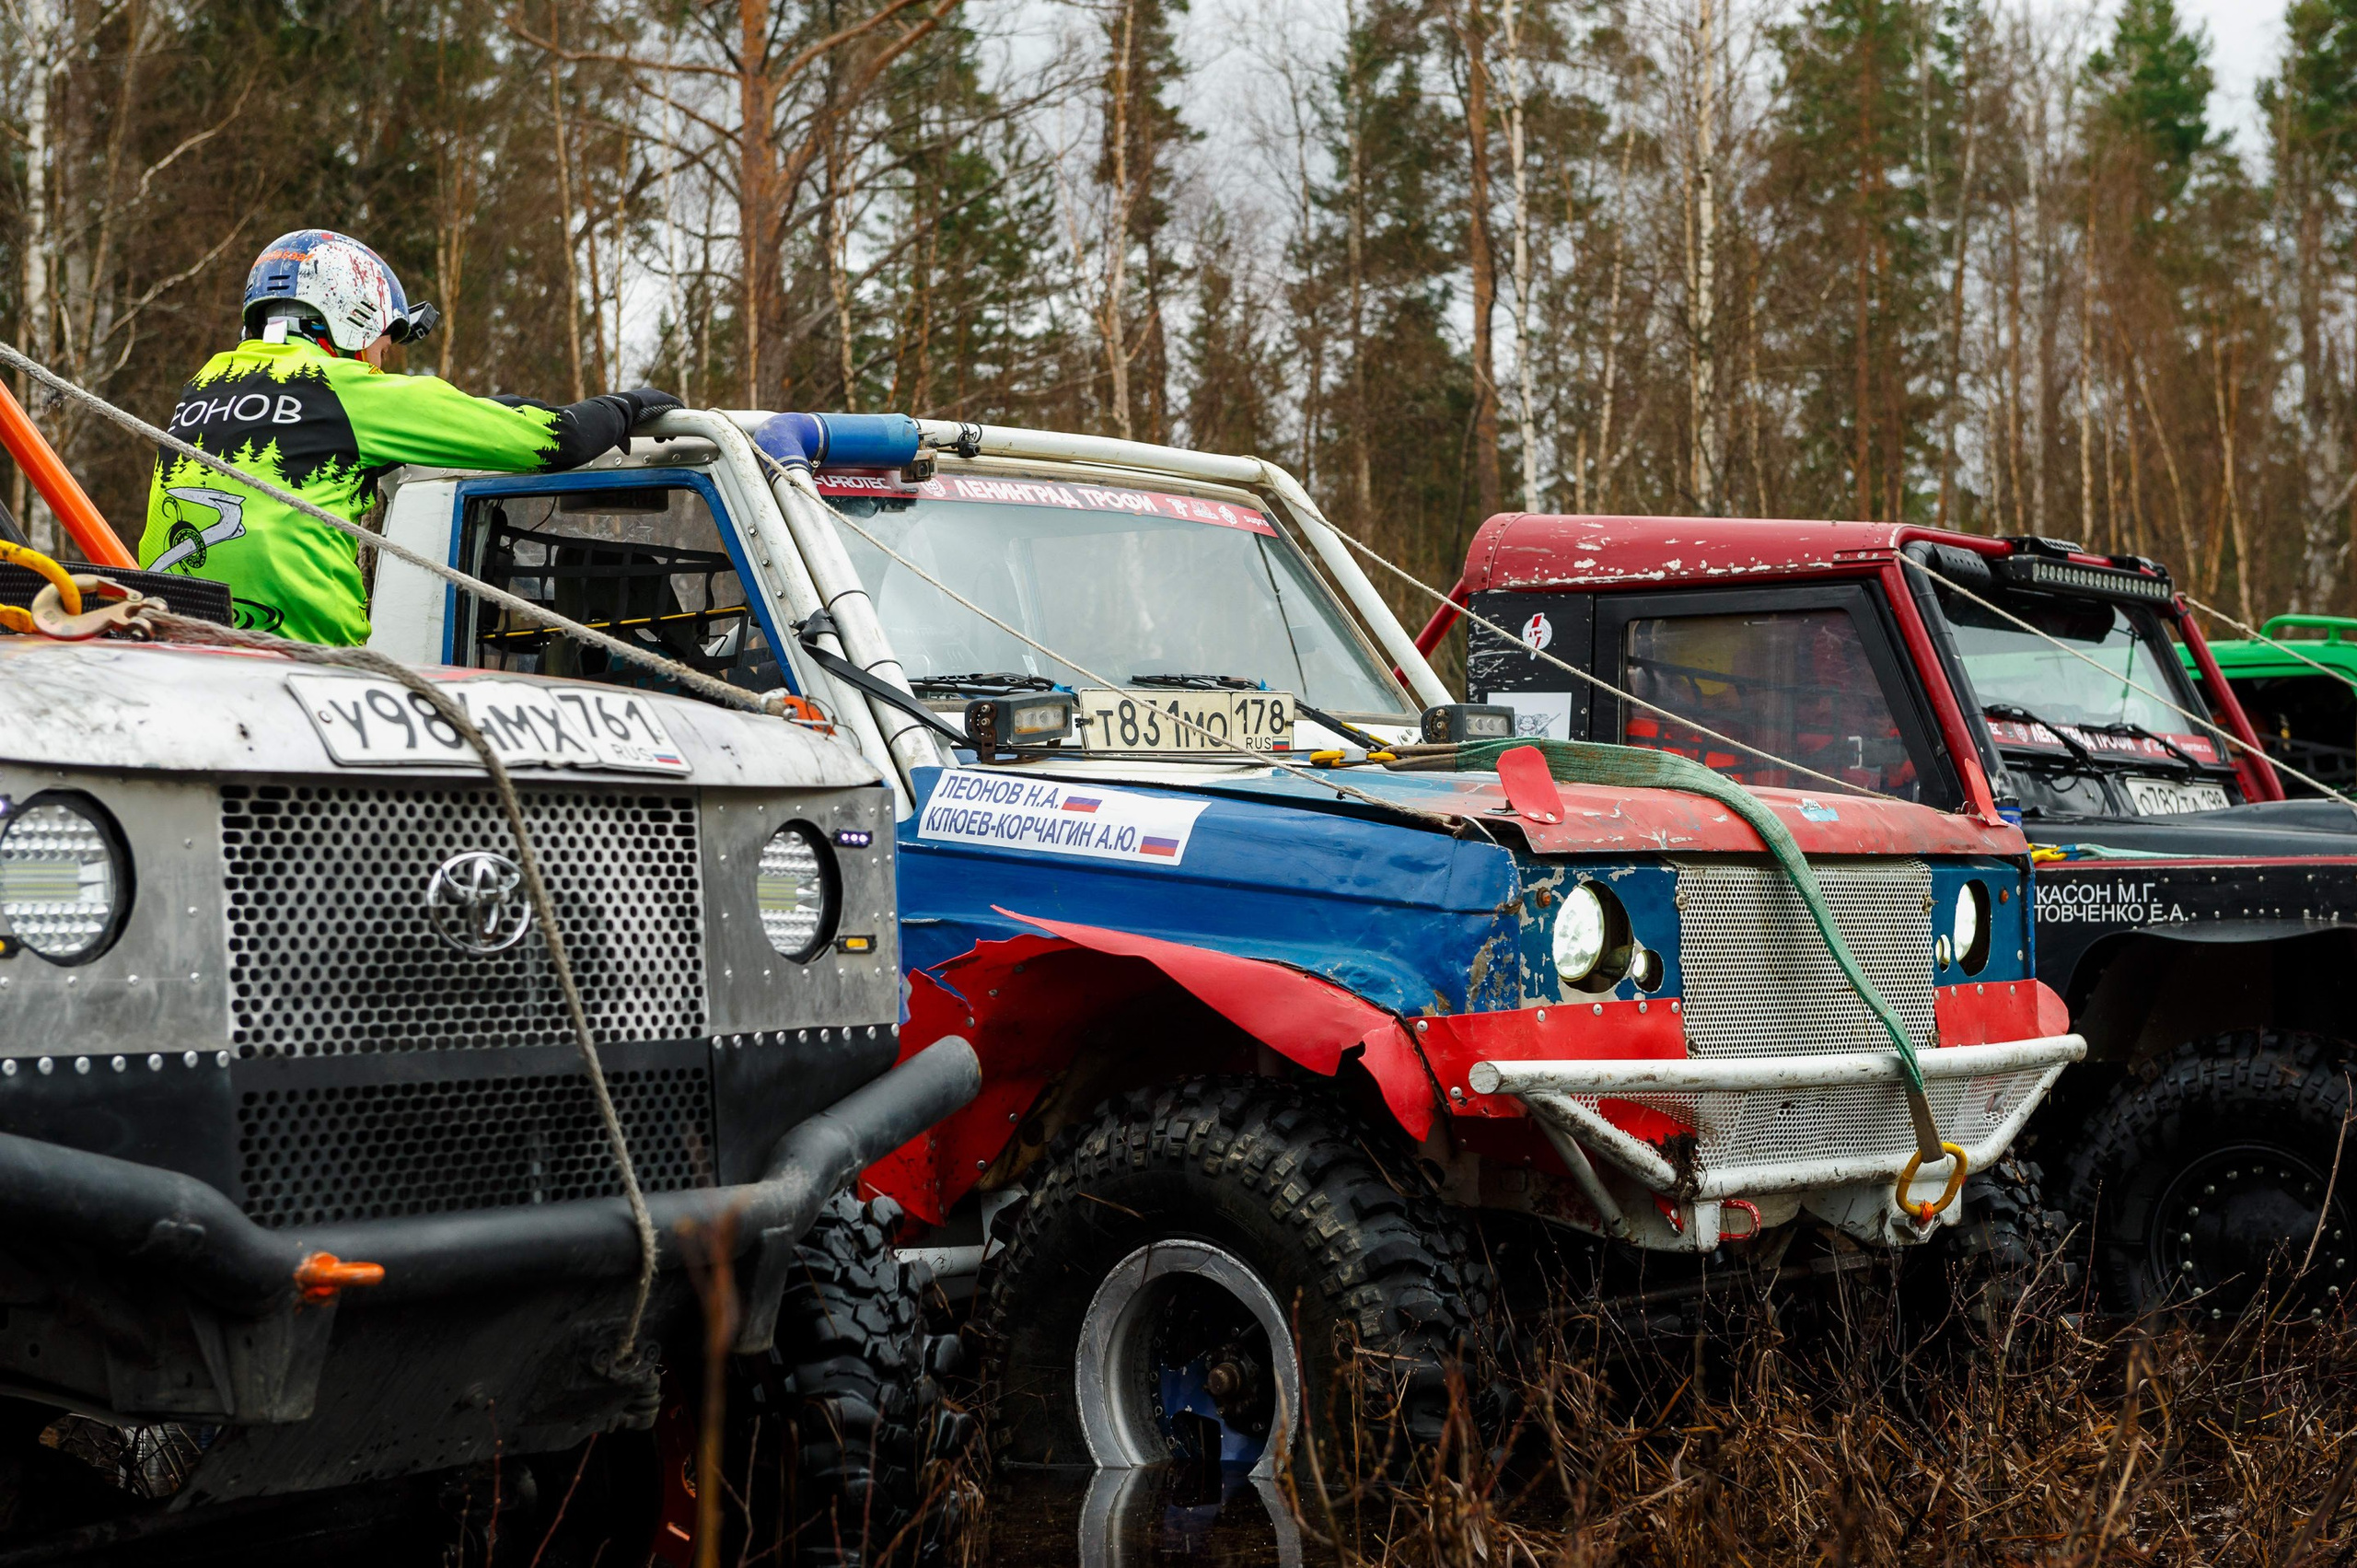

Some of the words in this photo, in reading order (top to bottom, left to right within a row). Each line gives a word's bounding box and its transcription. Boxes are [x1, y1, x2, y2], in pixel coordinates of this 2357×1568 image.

[954, 480, 1084, 509] ЛЕНИНГРАД
[1077, 489, 1159, 513] ТРОФИ
[1235, 699, 1284, 735] 178
[610, 743, 654, 761] RUS
[1246, 737, 1271, 750] RUS
[938, 775, 1025, 805] ЛЕОНОВ
[1023, 785, 1059, 809] Н.А.
[925, 807, 1093, 848] КЛЮЕВ-КОРЧАГИН
[1094, 825, 1137, 853] А.Ю.
[2034, 883, 2110, 904] КАСОН
[2118, 883, 2157, 903] М.Г.
[2034, 904, 2143, 923] ТОВЧЕНКО
